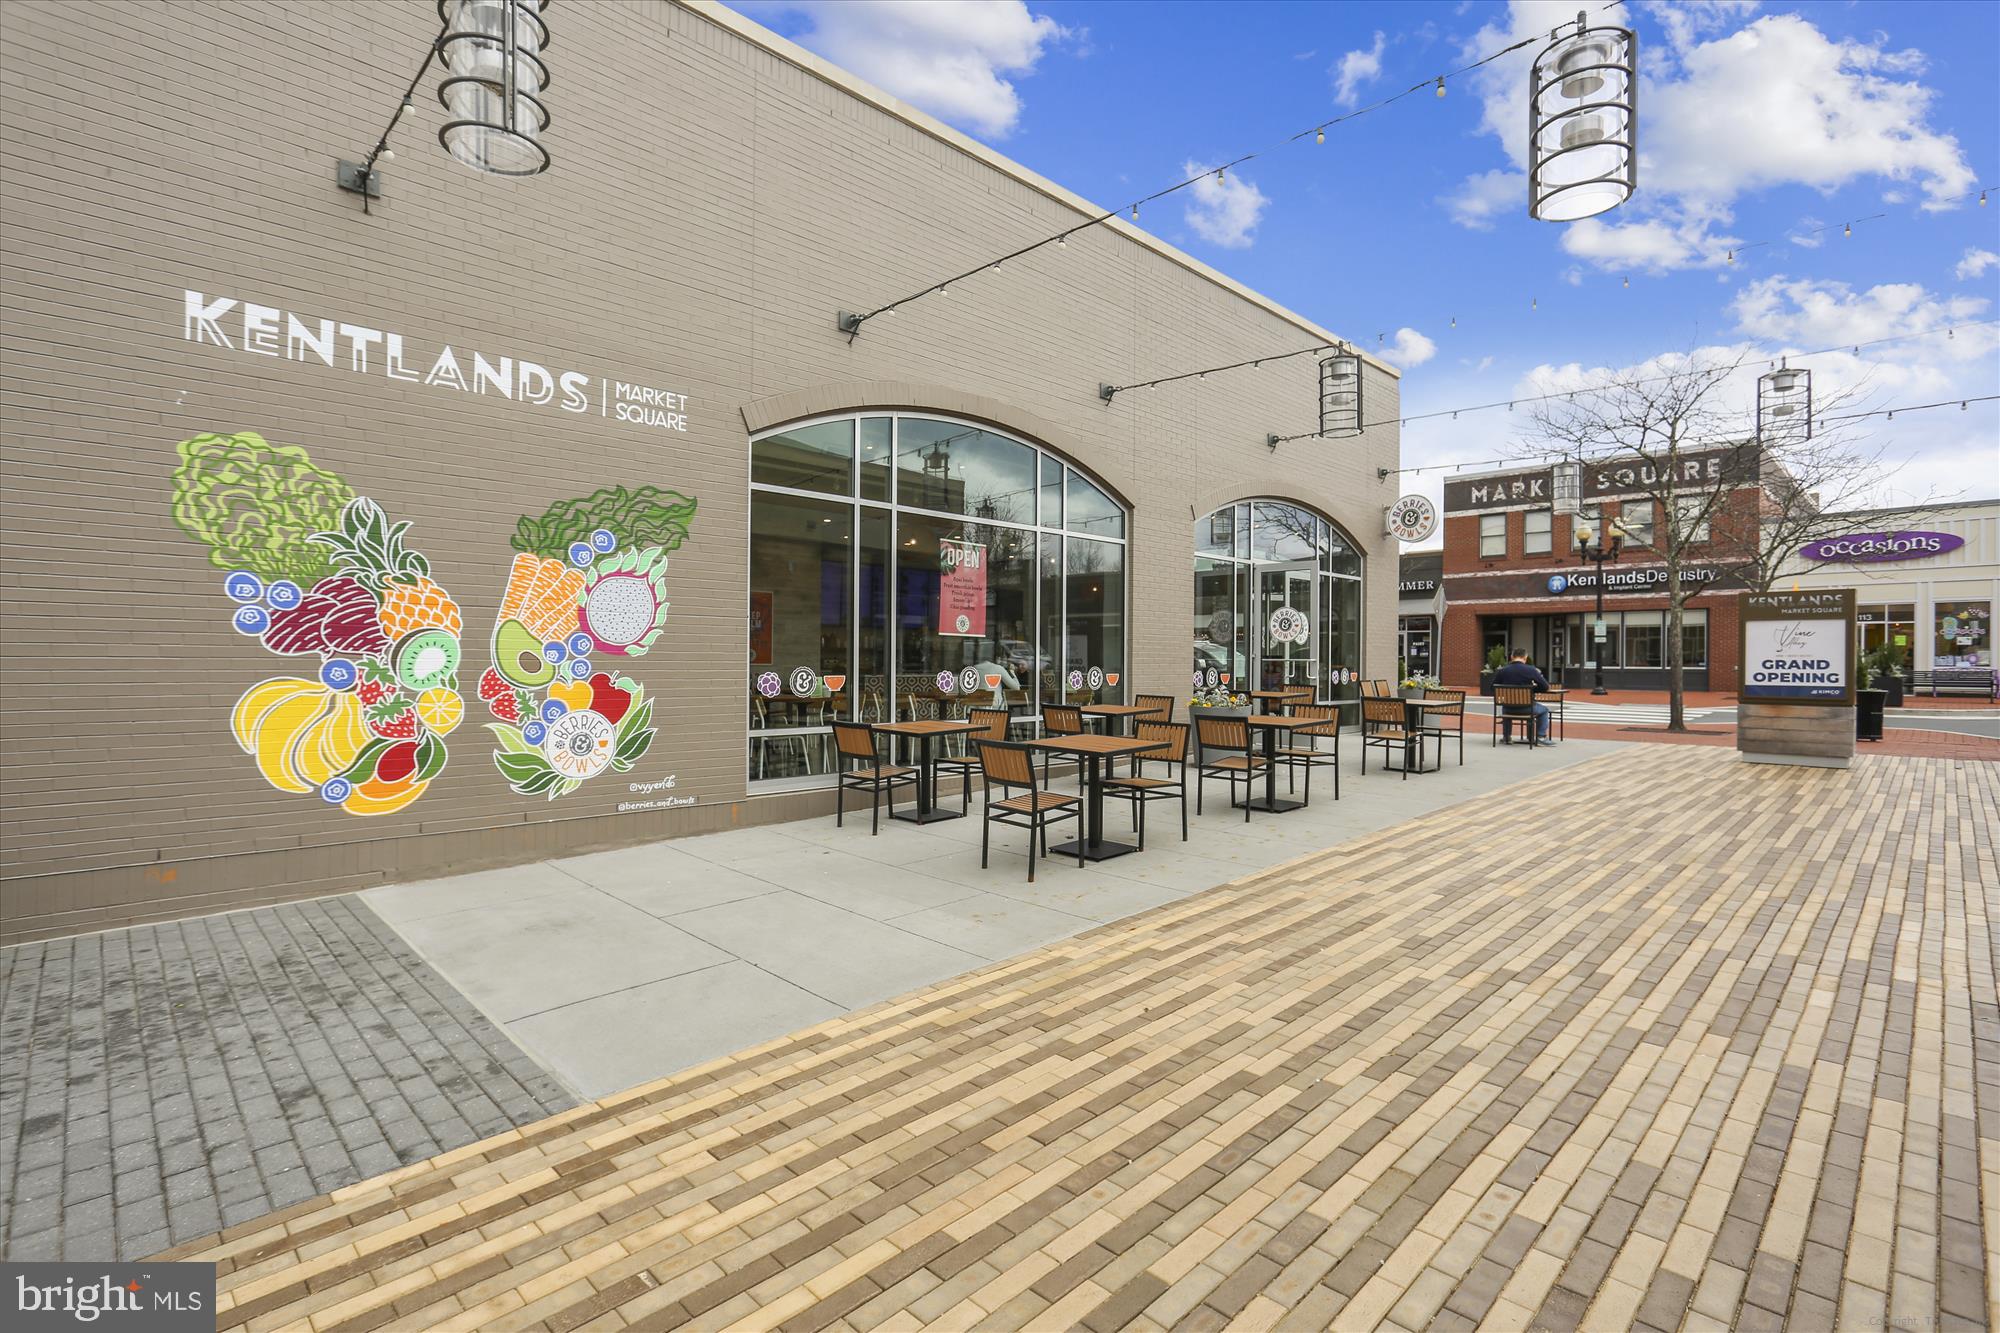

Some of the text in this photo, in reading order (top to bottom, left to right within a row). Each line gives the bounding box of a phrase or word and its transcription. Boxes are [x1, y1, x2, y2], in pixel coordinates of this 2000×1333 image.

[184, 290, 590, 413] KENTLANDS
[615, 381, 688, 411] MARKET
[615, 402, 688, 432] SQUARE
[1471, 458, 1720, 504] MARK SQUARE
[1392, 499, 1430, 518] BERRIES
[1404, 511, 1417, 525] &
[1393, 523, 1428, 538] BOWLS
[1819, 536, 1941, 558] occasions
[947, 548, 980, 569] OPEN
[1273, 610, 1299, 623] BERRIES
[1281, 620, 1291, 630] &
[1273, 628, 1298, 639] BOWLS
[1761, 659, 1831, 670] GRAND
[1752, 672, 1840, 684] OPENING
[553, 714, 609, 740] BERRIES
[574, 736, 590, 753] &
[553, 748, 608, 773] BOWLS
